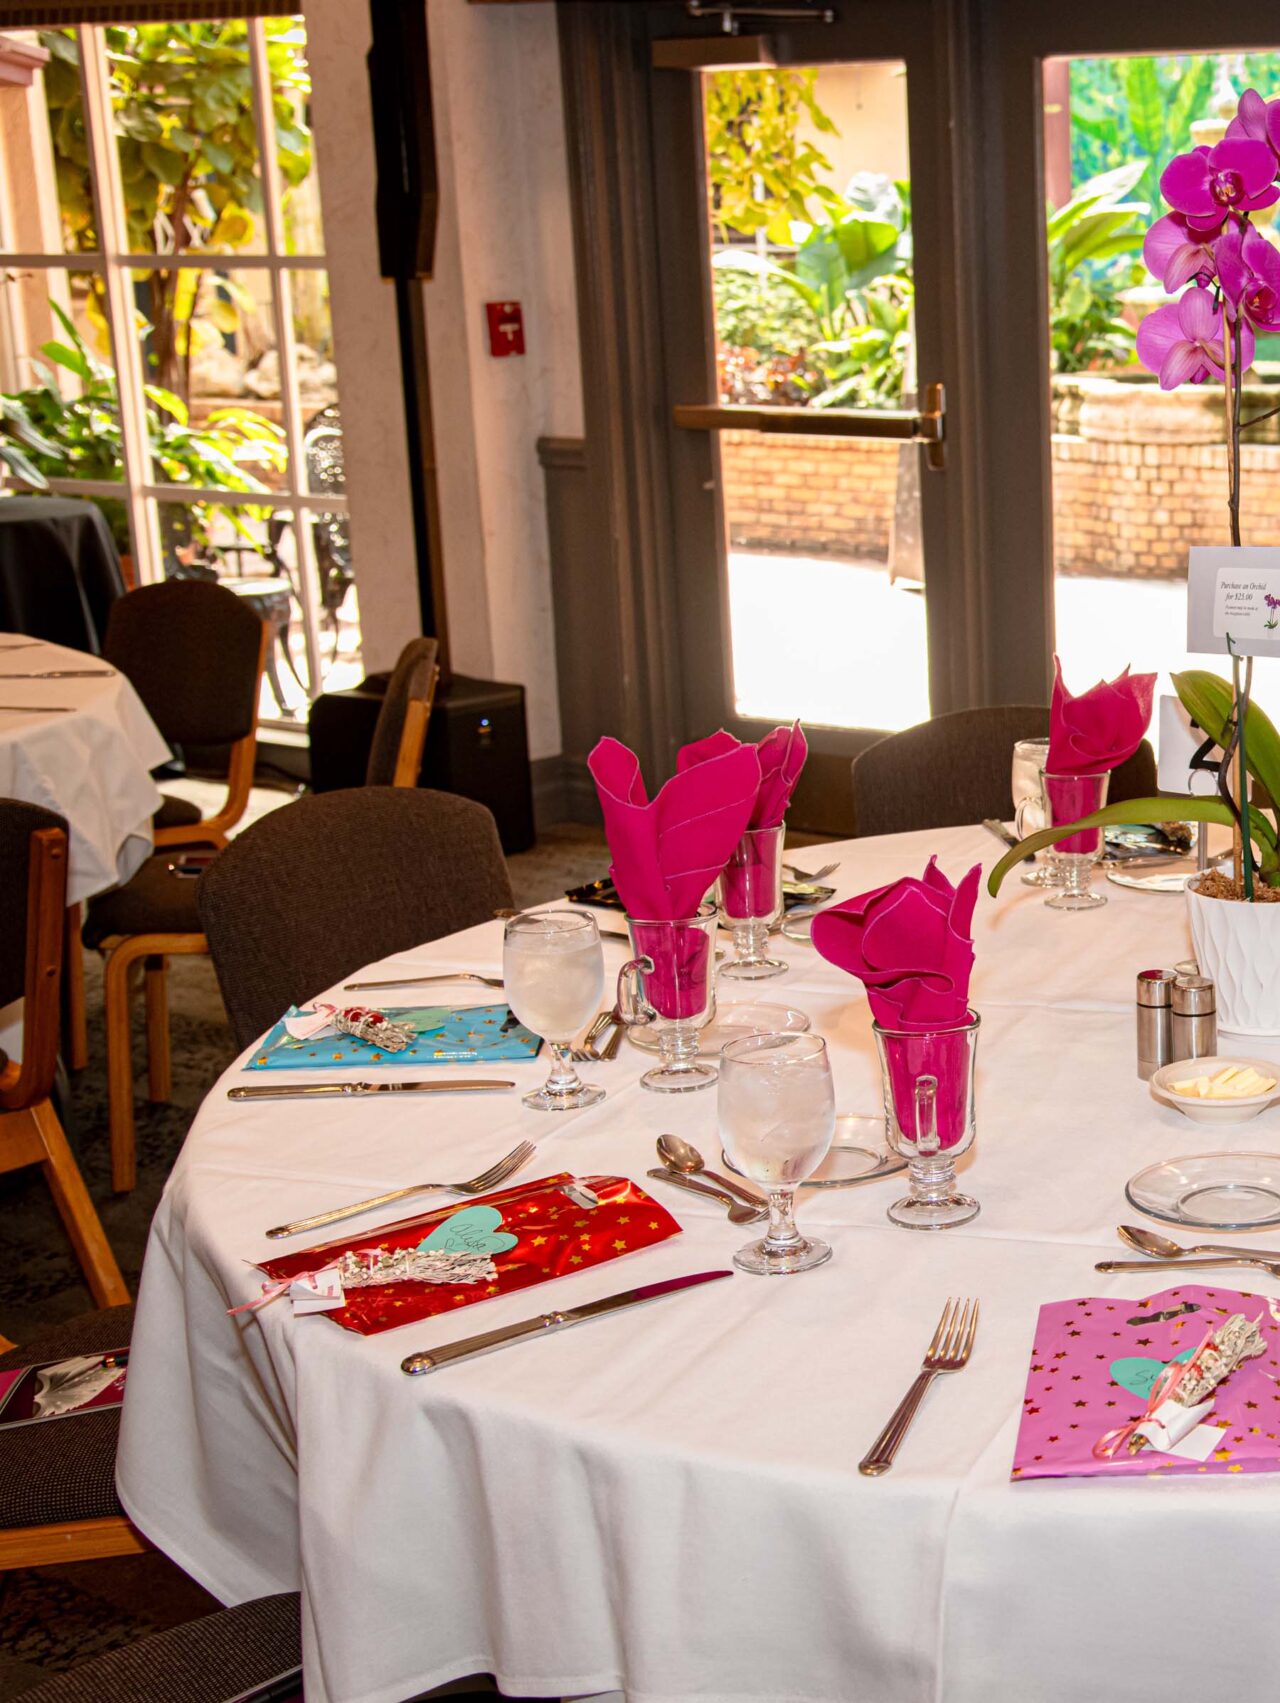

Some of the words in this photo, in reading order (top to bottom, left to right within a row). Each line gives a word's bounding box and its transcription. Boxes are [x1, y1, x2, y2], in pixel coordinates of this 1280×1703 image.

[1220, 581, 1242, 590] Purchase
[1249, 582, 1267, 591] Orchid
[1225, 592, 1234, 602] for
[1234, 592, 1253, 601] $25.00
